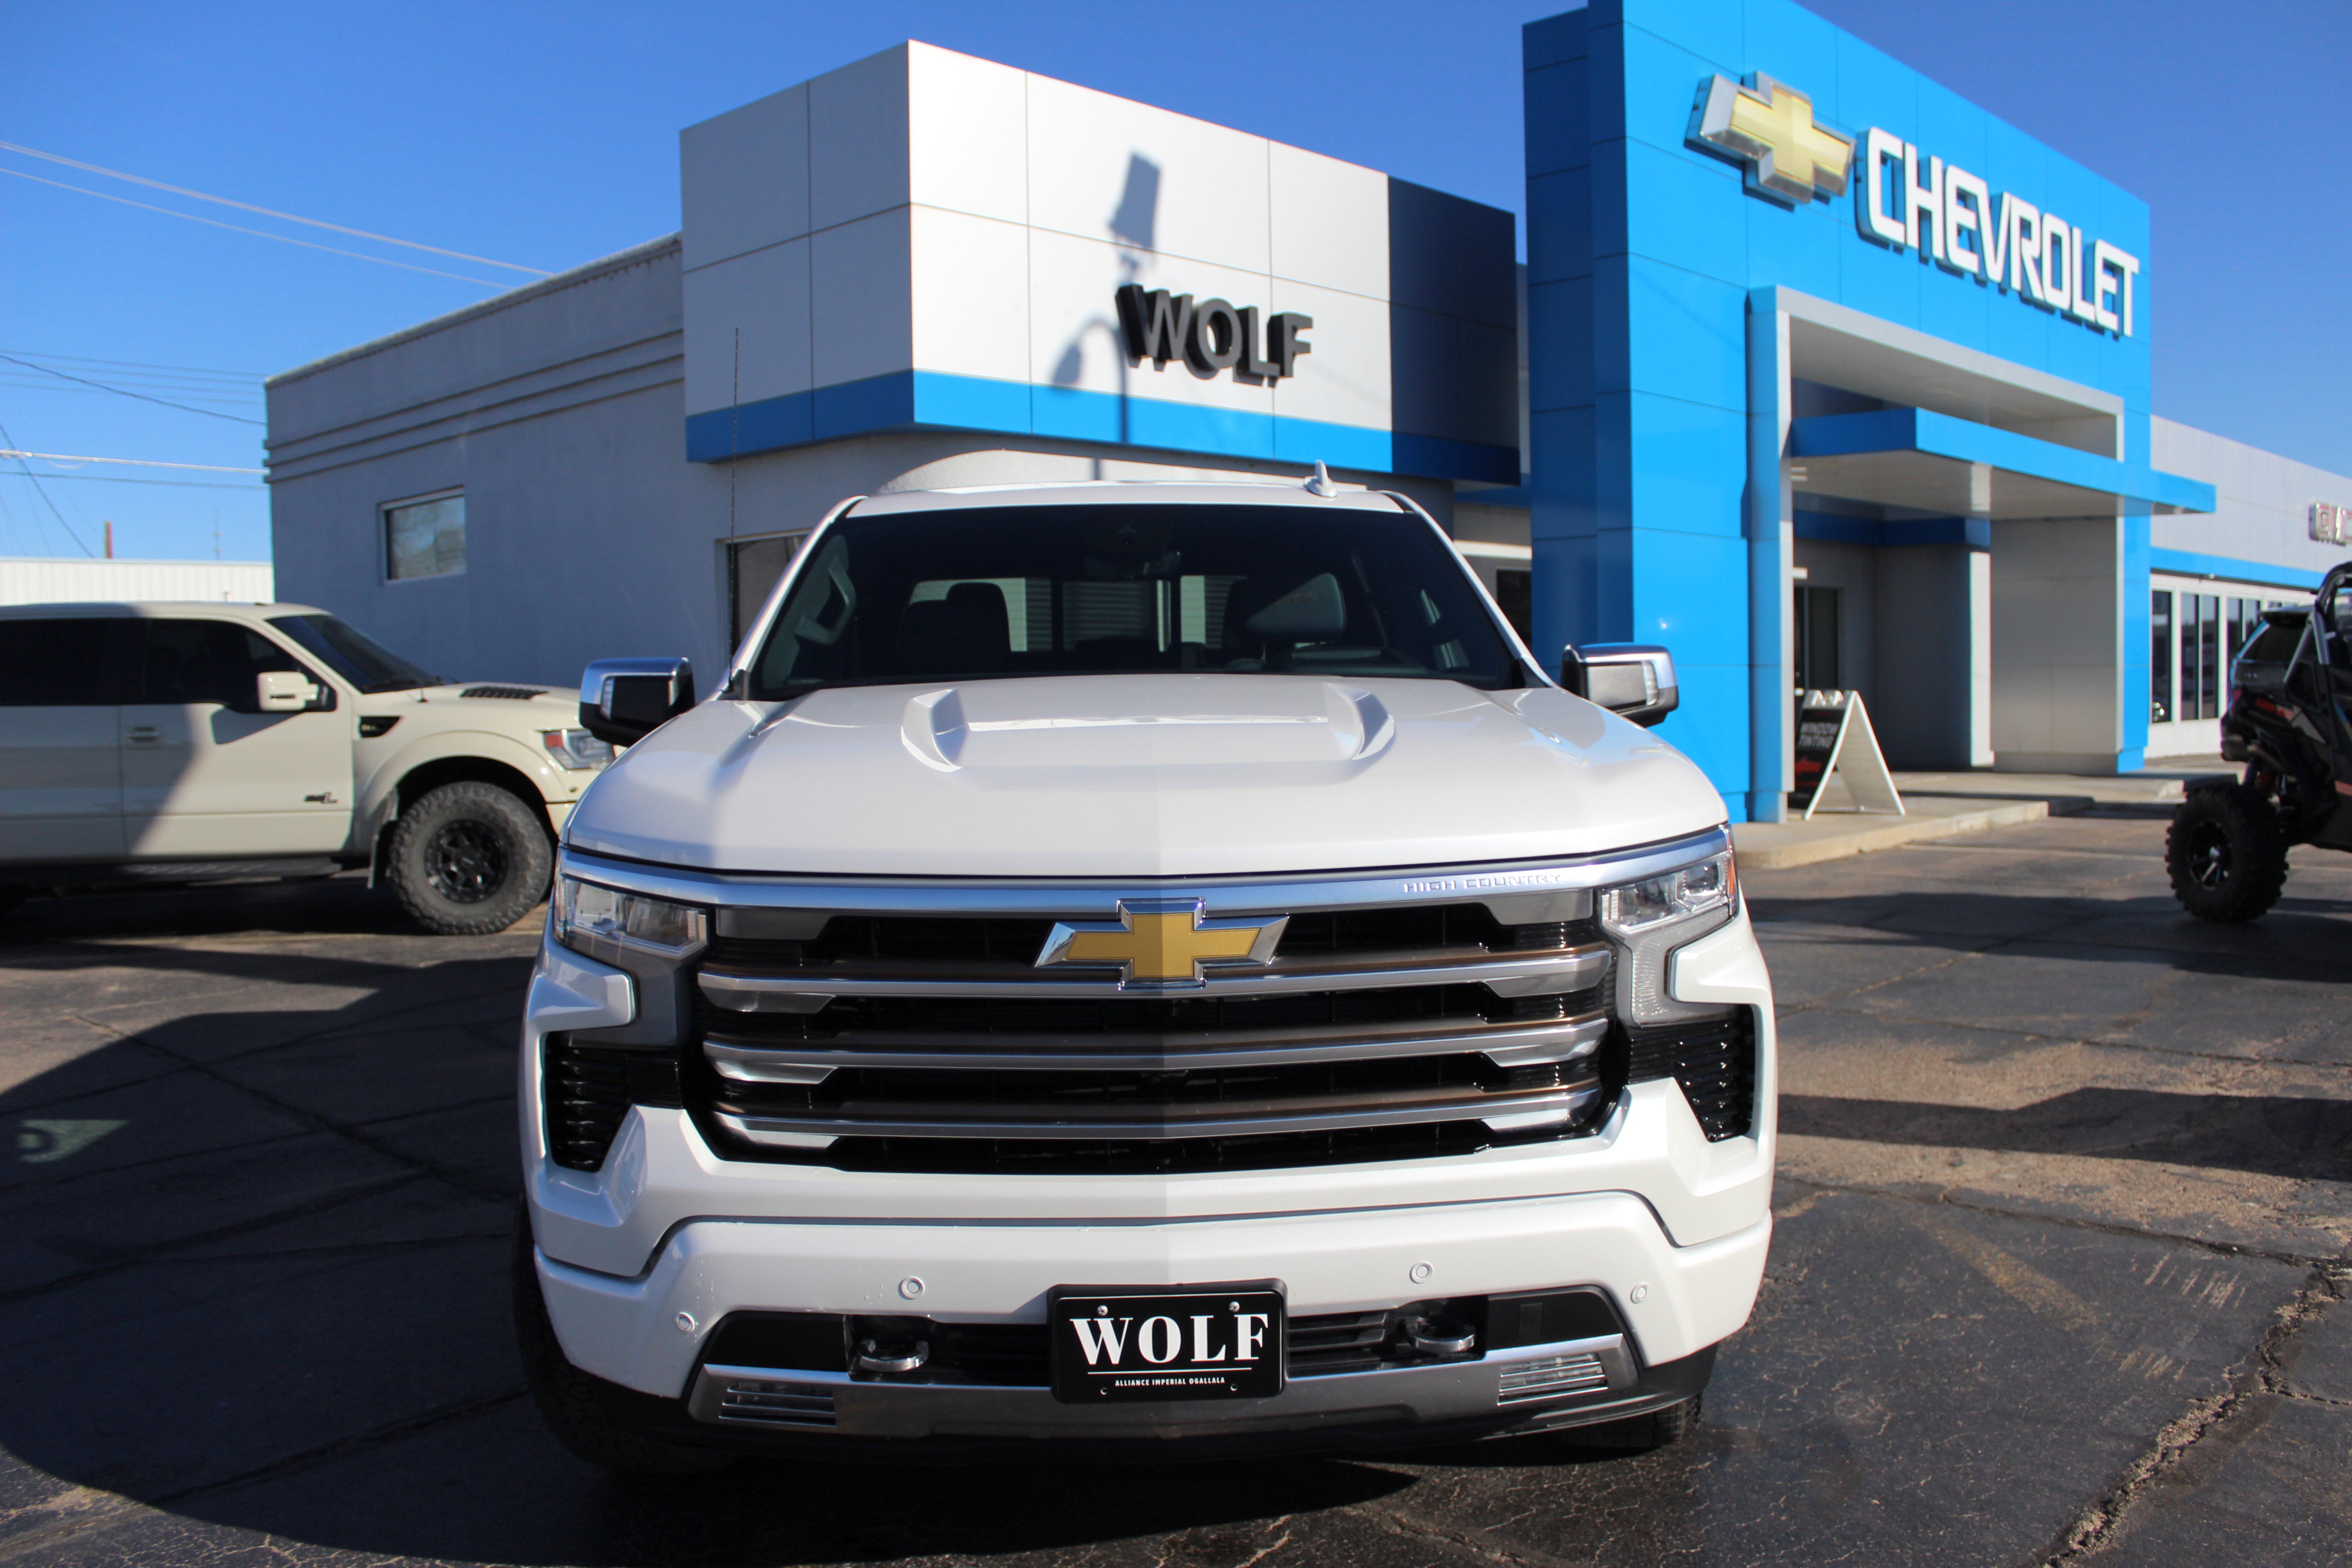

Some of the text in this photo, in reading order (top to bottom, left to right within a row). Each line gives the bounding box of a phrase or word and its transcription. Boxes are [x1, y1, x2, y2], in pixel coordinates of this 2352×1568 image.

[1866, 126, 2139, 338] CHEVROLET
[1116, 283, 1313, 381] WOLF
[1404, 874, 1561, 893] HIGH COUNTRY
[1069, 1314, 1268, 1365] WOLF
